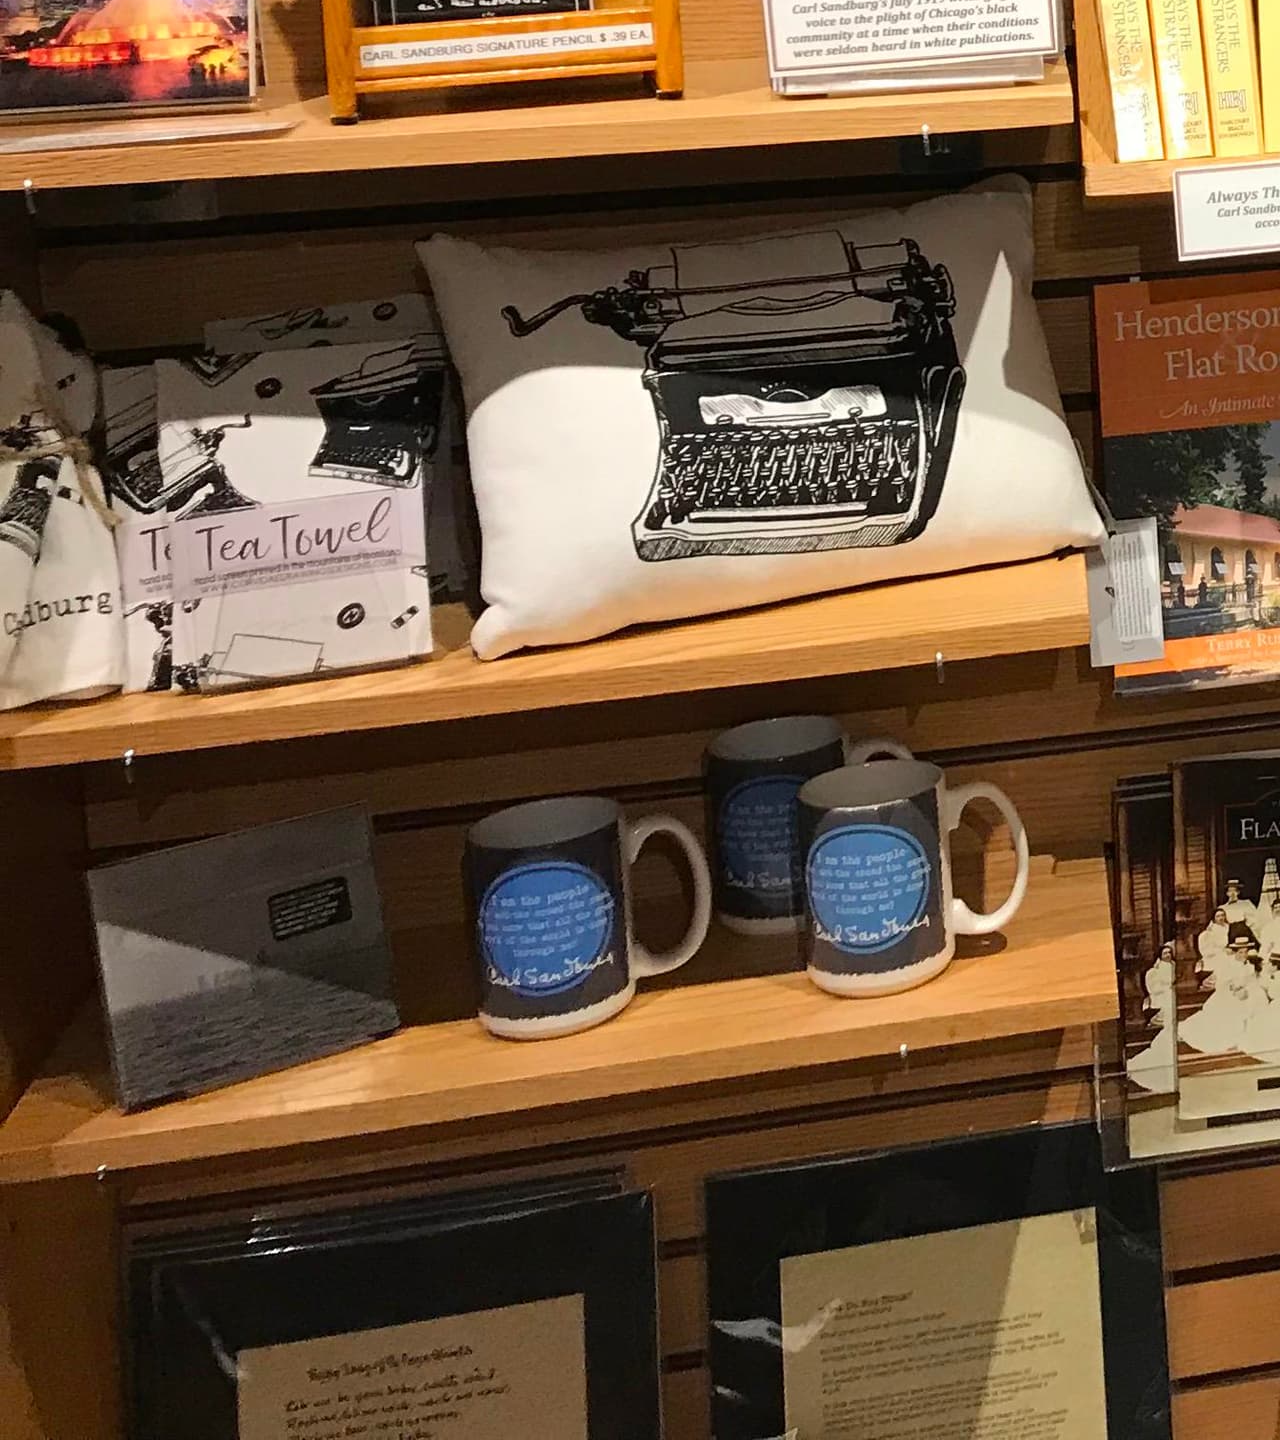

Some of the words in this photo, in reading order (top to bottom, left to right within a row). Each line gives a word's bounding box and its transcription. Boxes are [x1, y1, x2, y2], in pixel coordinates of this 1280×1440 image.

[1207, 190, 1258, 204] Always
[1165, 347, 1227, 383] Flat
[196, 524, 272, 571] Tea
[270, 497, 392, 563] Towel
